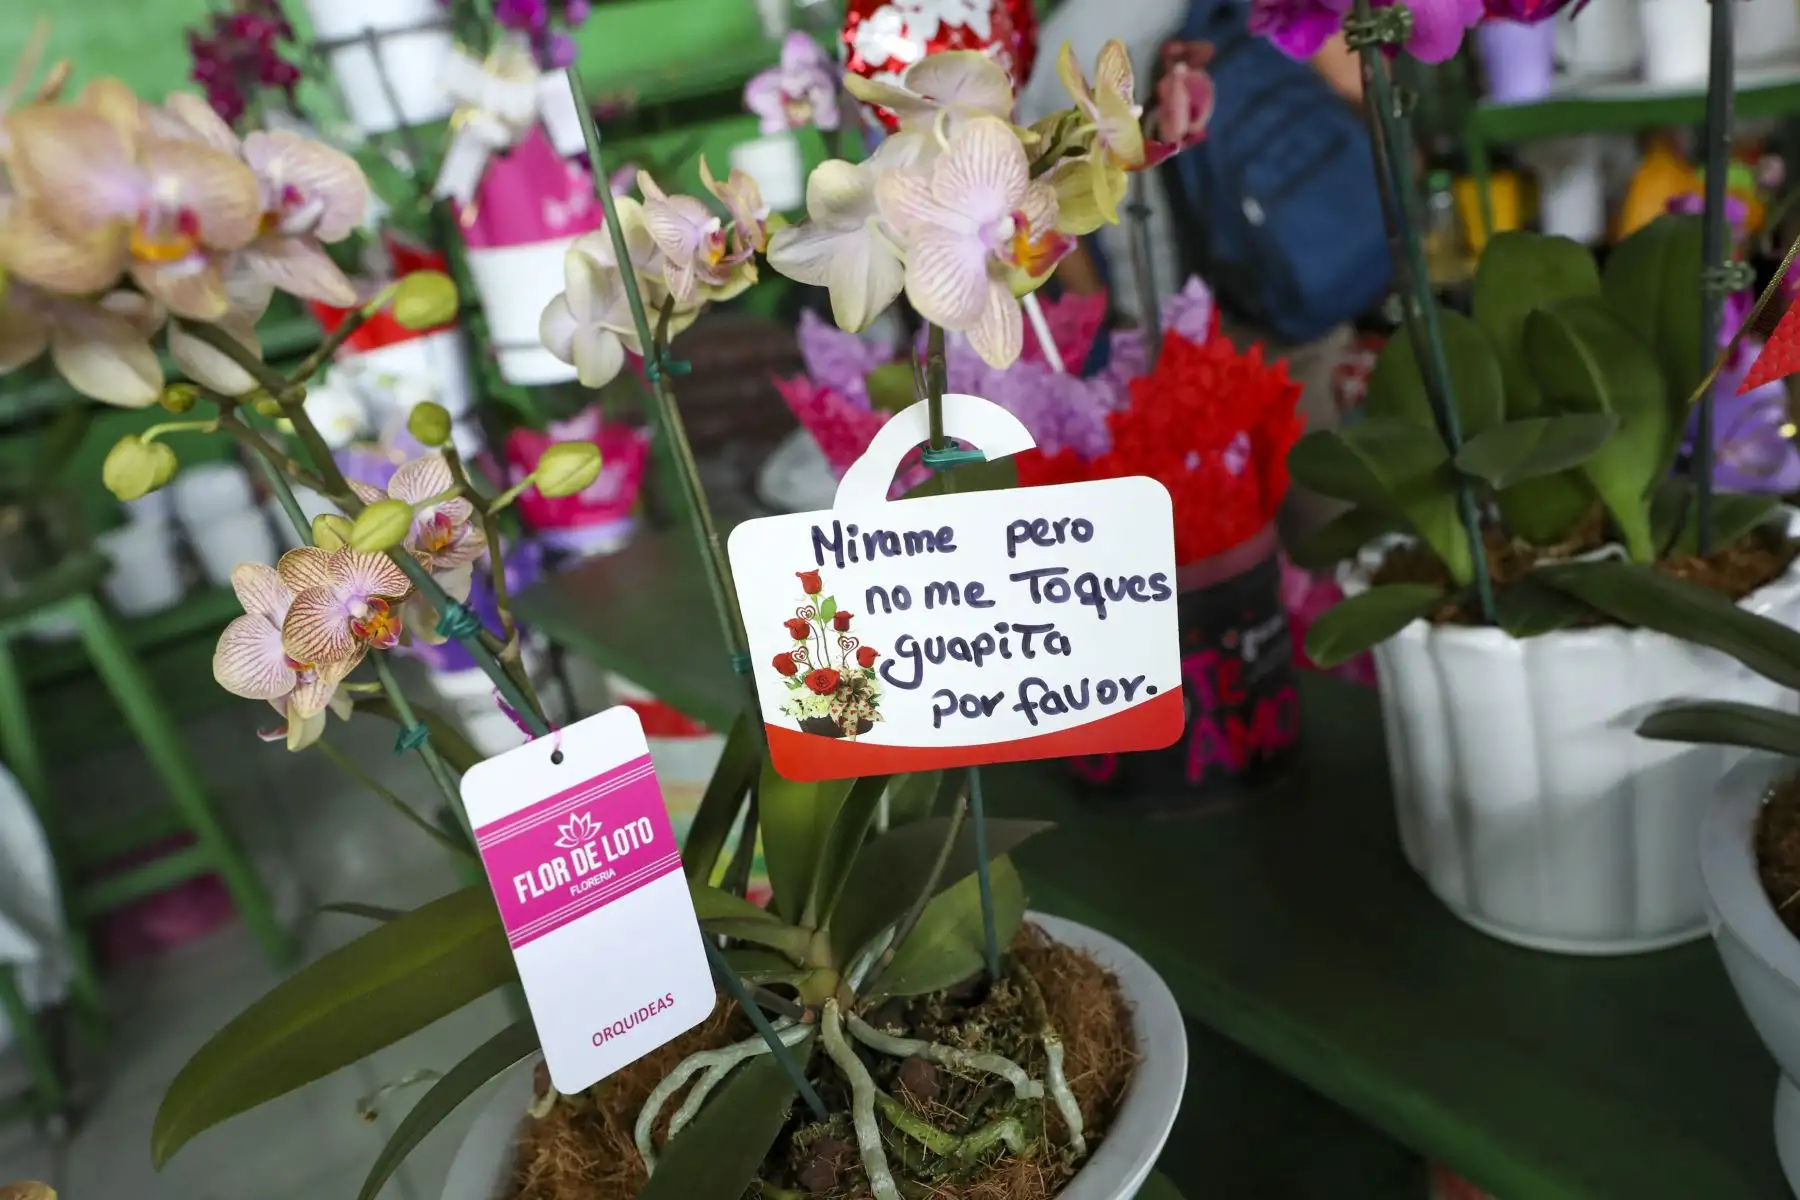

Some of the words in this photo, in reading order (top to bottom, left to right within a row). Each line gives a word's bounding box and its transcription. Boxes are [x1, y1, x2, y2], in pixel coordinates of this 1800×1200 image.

[1007, 517, 1095, 558] pero
[865, 584, 912, 615] no
[924, 580, 996, 609] me
[1009, 567, 1173, 620] Toques
[932, 688, 1005, 729] por
[1012, 675, 1158, 727] favor.
[1182, 649, 1245, 711] TE
[1186, 683, 1301, 783] AMO
[513, 856, 571, 904] FLOR
[570, 841, 603, 877] DE
[601, 816, 655, 862] LOTO
[570, 868, 617, 897] FLORERIA
[591, 992, 675, 1047] ORQUIDEAS
